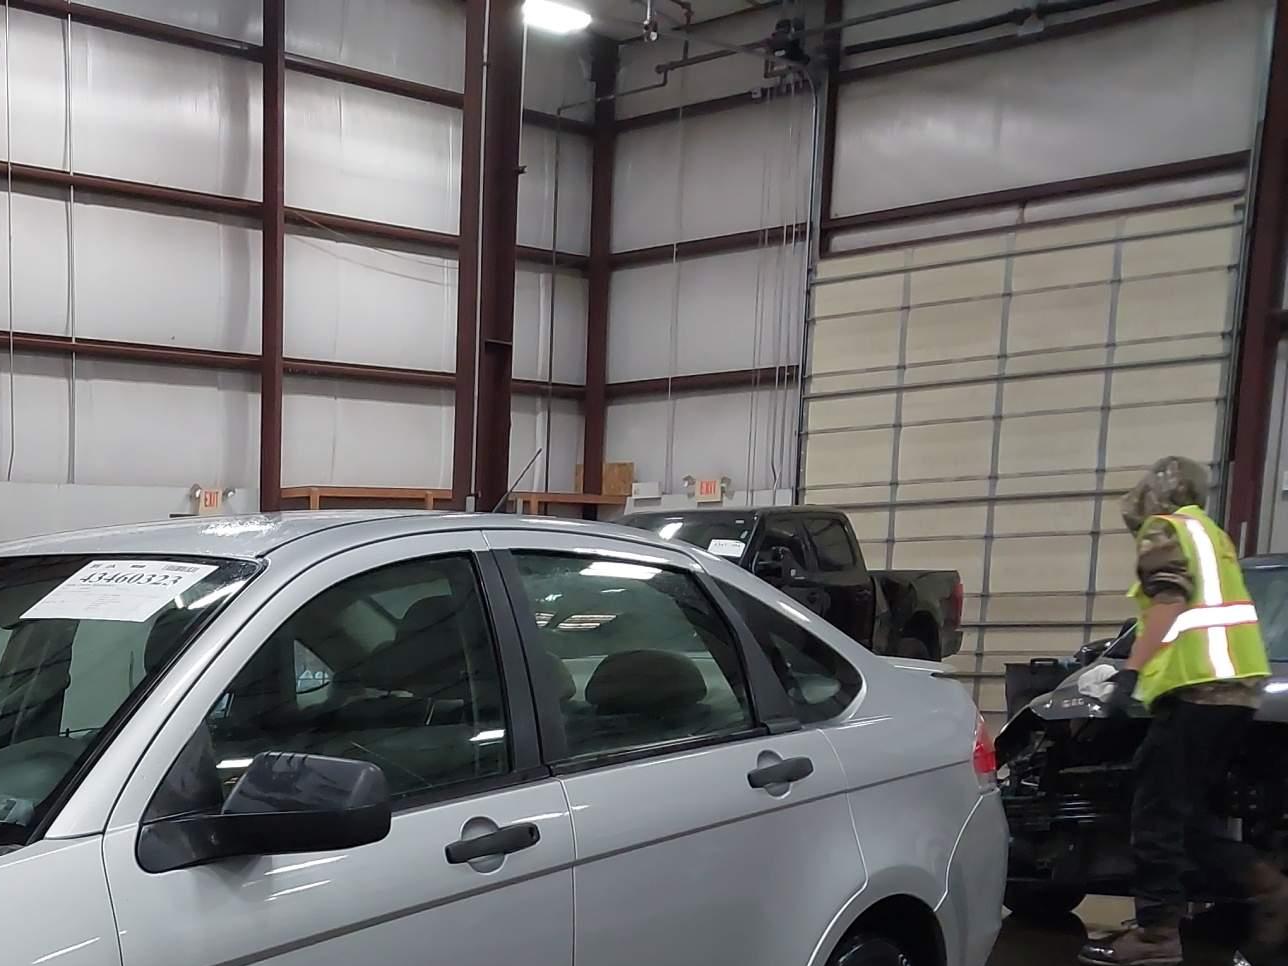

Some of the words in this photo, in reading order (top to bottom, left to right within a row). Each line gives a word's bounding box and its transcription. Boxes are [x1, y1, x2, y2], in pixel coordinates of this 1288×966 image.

[699, 480, 717, 496] EXIT
[203, 490, 219, 507] EXIT
[80, 572, 183, 586] 43460323
